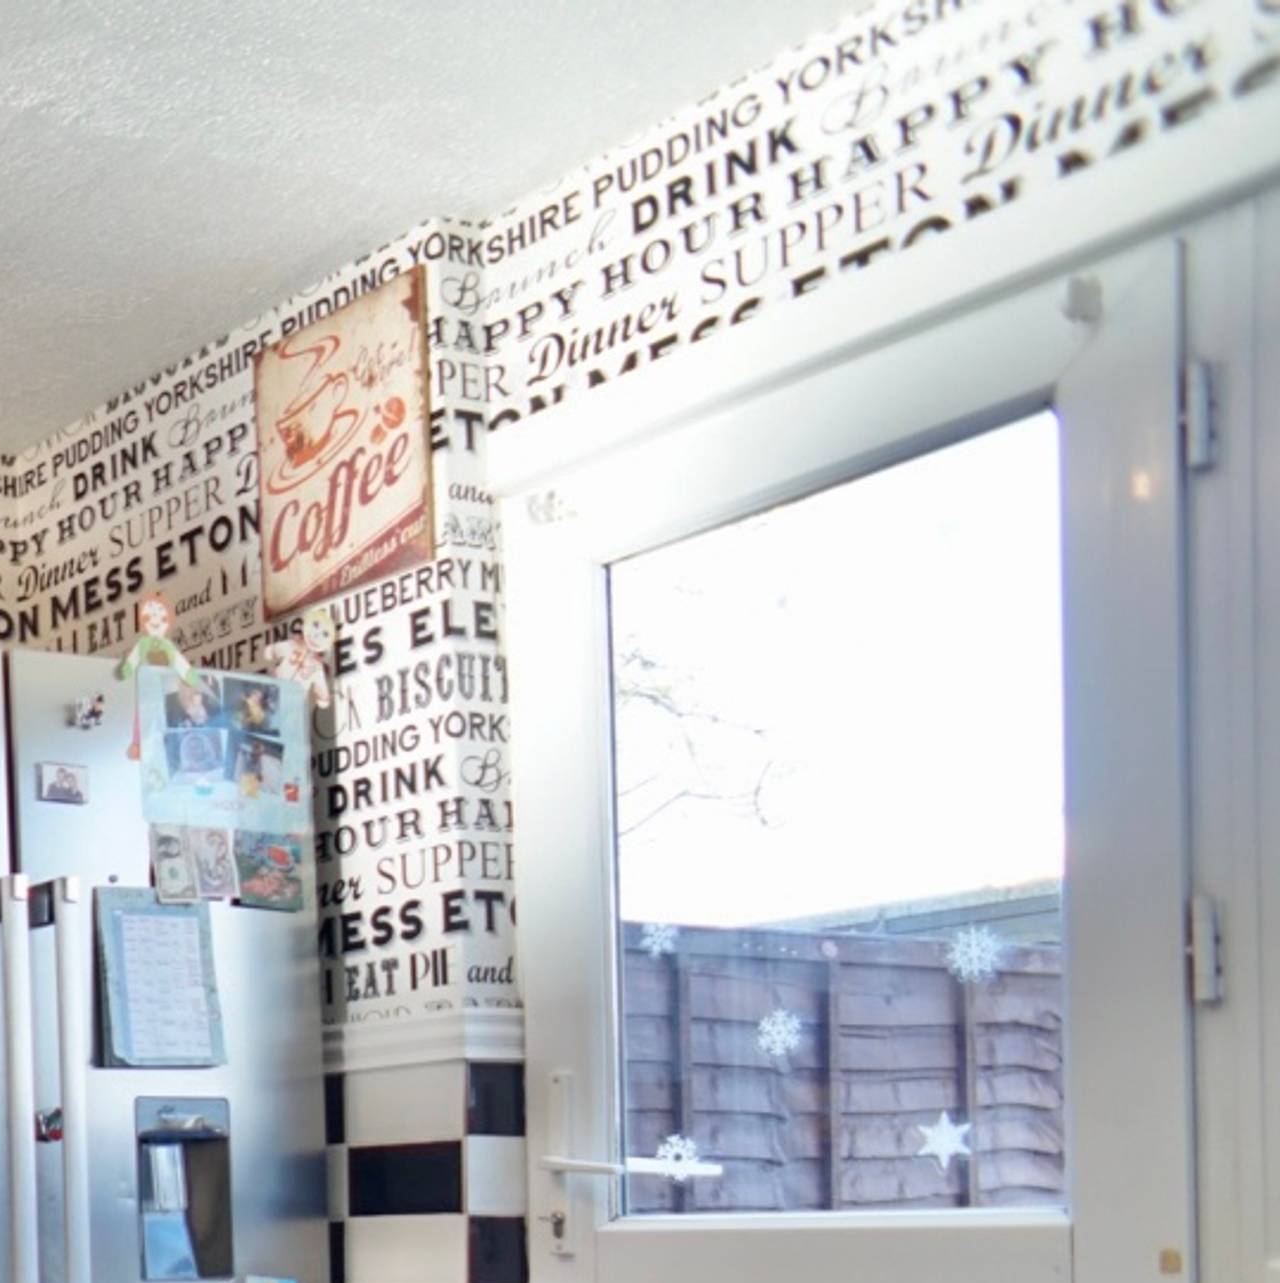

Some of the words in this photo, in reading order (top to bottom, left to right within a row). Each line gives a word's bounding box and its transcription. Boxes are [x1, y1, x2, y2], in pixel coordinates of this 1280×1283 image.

[51, 409, 140, 478] PUDDING
[407, 190, 582, 269] YORKSHIRE
[593, 93, 762, 208] PUDDING
[72, 431, 158, 501] DRINK
[630, 115, 800, 236] DRINK
[17, 548, 102, 603] Dinner
[108, 475, 224, 559] SUPPER
[526, 290, 682, 387] Dinner
[699, 161, 933, 306] SUPPER
[57, 479, 142, 544] HOUR
[151, 420, 256, 494] HAPP
[600, 190, 765, 297] HOUR
[50, 556, 145, 631] MESS
[155, 499, 261, 582] ETON
[175, 578, 213, 617] and
[329, 557, 473, 625] LUEBERRY
[311, 724, 421, 780] UDDING
[328, 751, 446, 821] DRINK
[345, 957, 400, 1003] EAT
[410, 946, 454, 992] PIE
[467, 956, 515, 985] and
